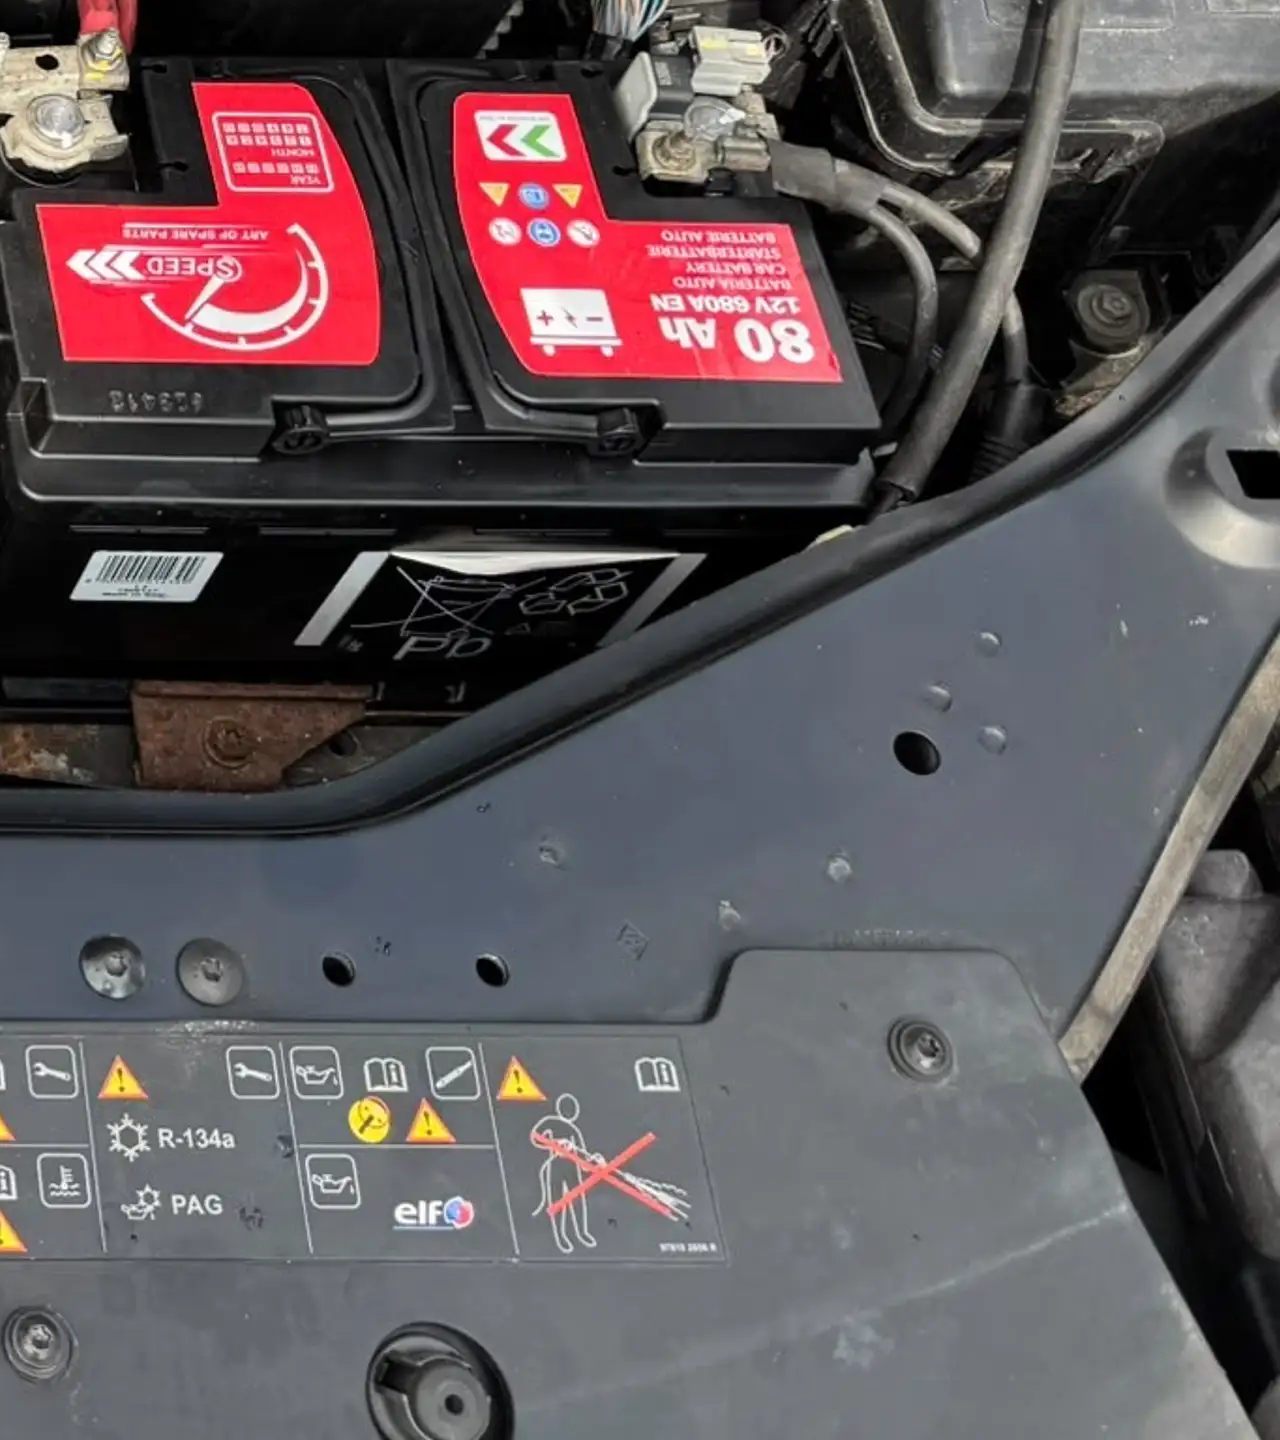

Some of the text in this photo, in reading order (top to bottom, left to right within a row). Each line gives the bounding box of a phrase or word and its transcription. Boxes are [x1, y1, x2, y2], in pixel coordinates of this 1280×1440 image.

[123, 227, 269, 241] ART OF SPARE PARTS
[660, 230, 776, 244] BATTERIE AUTO
[645, 244, 781, 260] STARTERBATTERIE
[146, 255, 237, 278] SPEED
[685, 262, 786, 275] CAR BATTERY
[673, 276, 792, 290] BATTERIA AUTO
[649, 293, 801, 315] 12V 680A EN
[659, 317, 815, 364] 80 Ah
[393, 628, 492, 661] Pb
[157, 1126, 236, 1150] R-134a
[171, 1195, 224, 1215] PAG
[394, 1200, 443, 1225] elf
